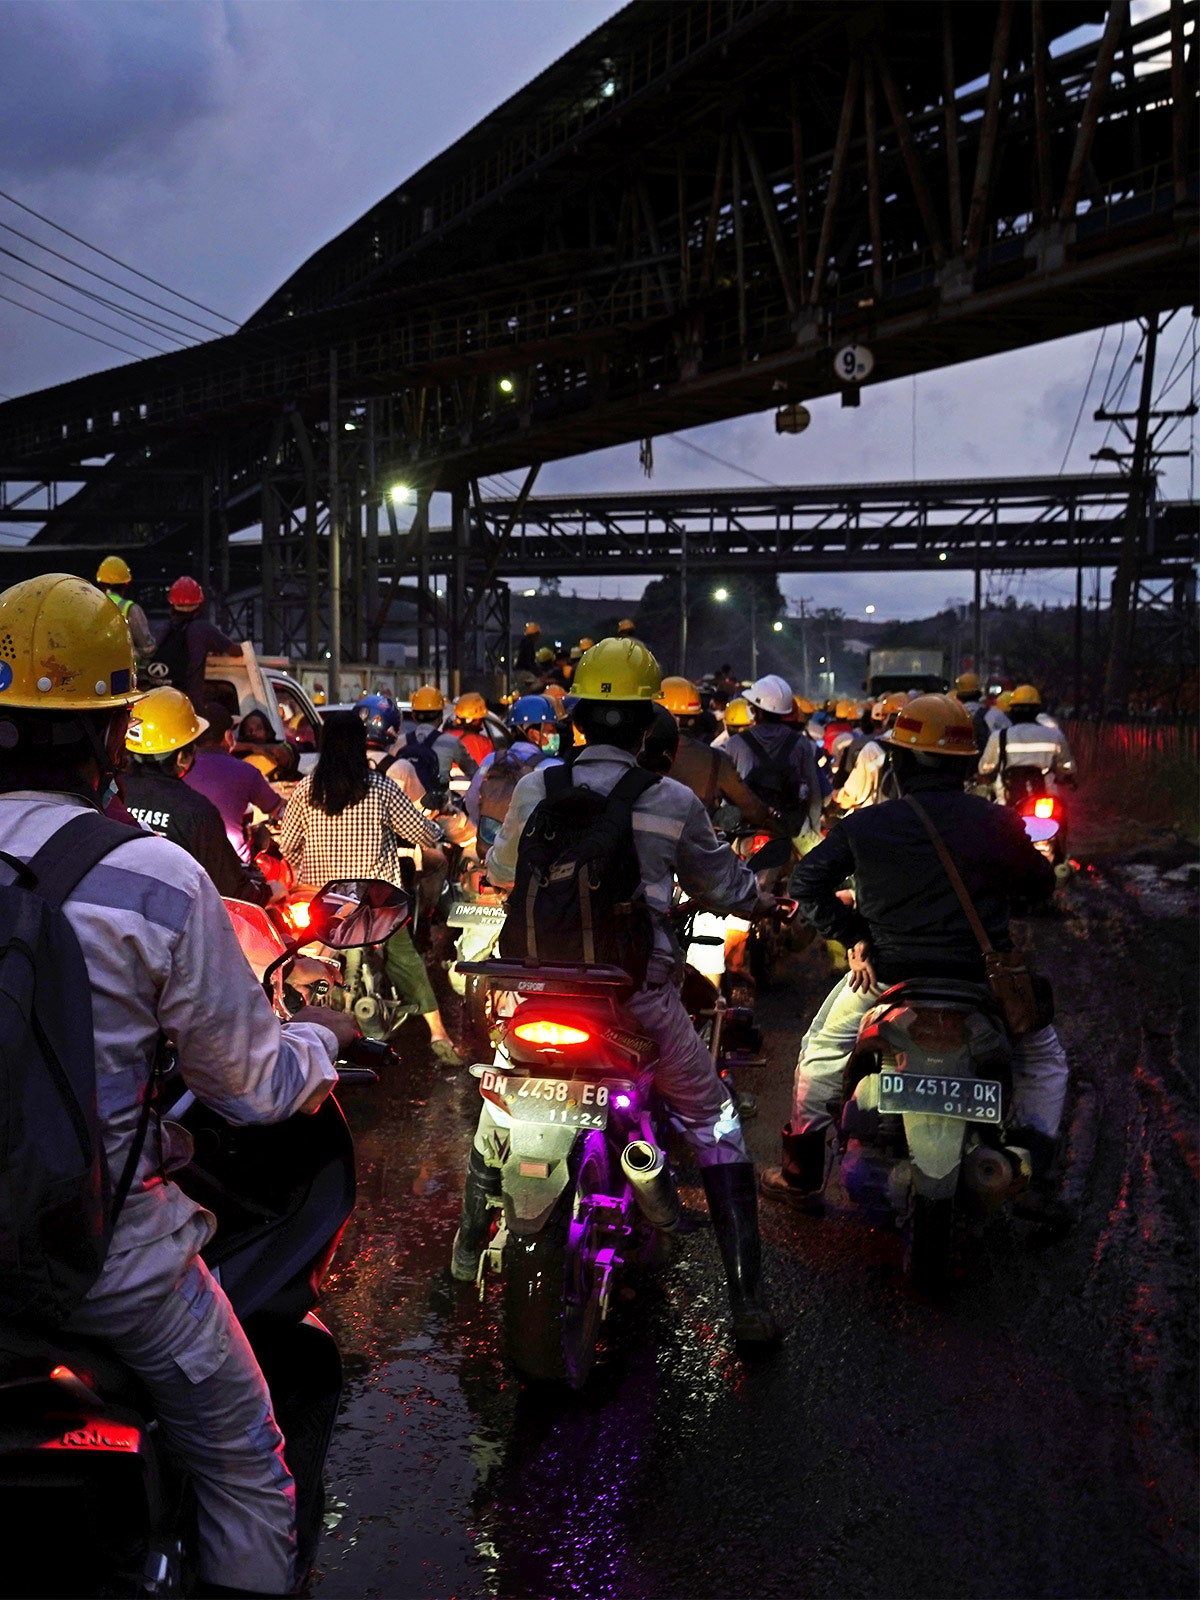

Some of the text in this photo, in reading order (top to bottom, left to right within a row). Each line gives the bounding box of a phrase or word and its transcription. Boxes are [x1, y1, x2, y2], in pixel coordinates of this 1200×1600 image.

[482, 1073, 508, 1096] DN
[518, 1079, 568, 1102] 4458
[882, 1075, 904, 1094] DD
[915, 1078, 960, 1098] 4512
